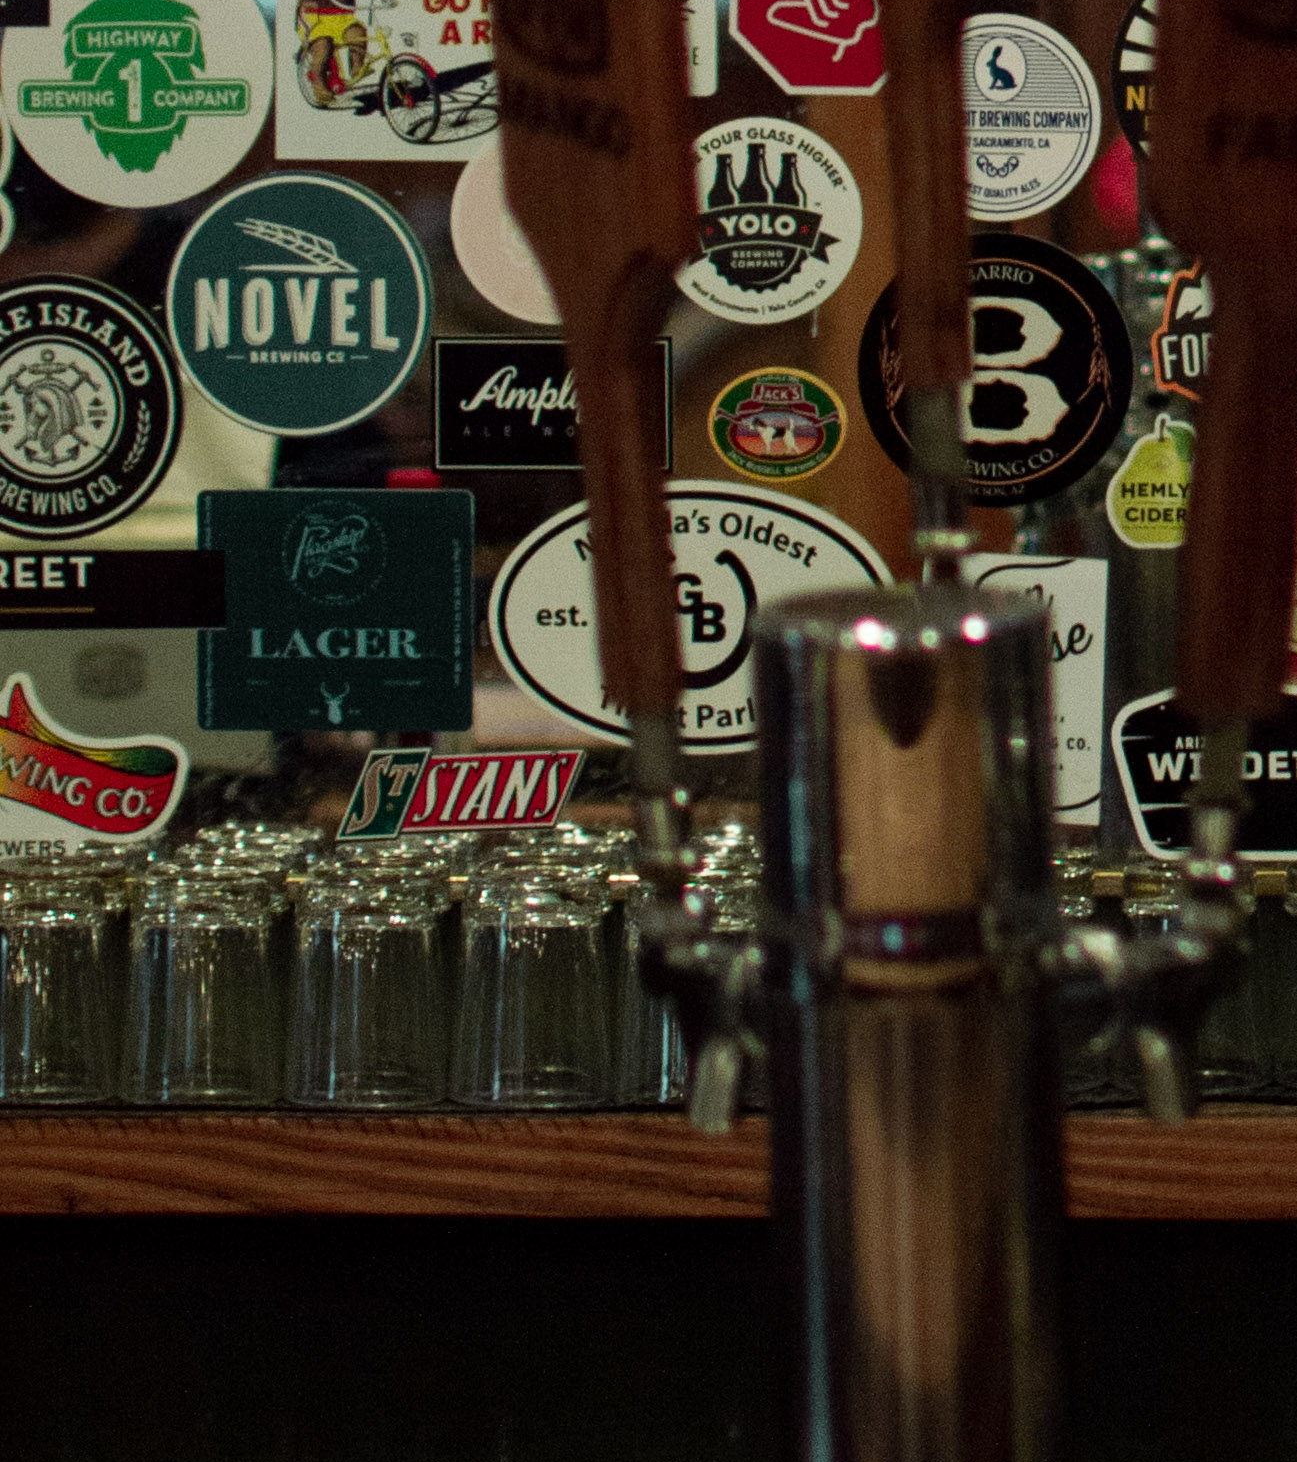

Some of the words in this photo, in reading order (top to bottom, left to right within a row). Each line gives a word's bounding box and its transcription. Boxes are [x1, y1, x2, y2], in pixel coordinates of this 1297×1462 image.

[88, 29, 180, 47] HIGHWAY
[28, 90, 115, 109] BREWING
[153, 90, 243, 109] COMPANY
[718, 215, 798, 237] YOLO
[194, 276, 400, 353] NOVEL
[248, 627, 422, 660] LAGER
